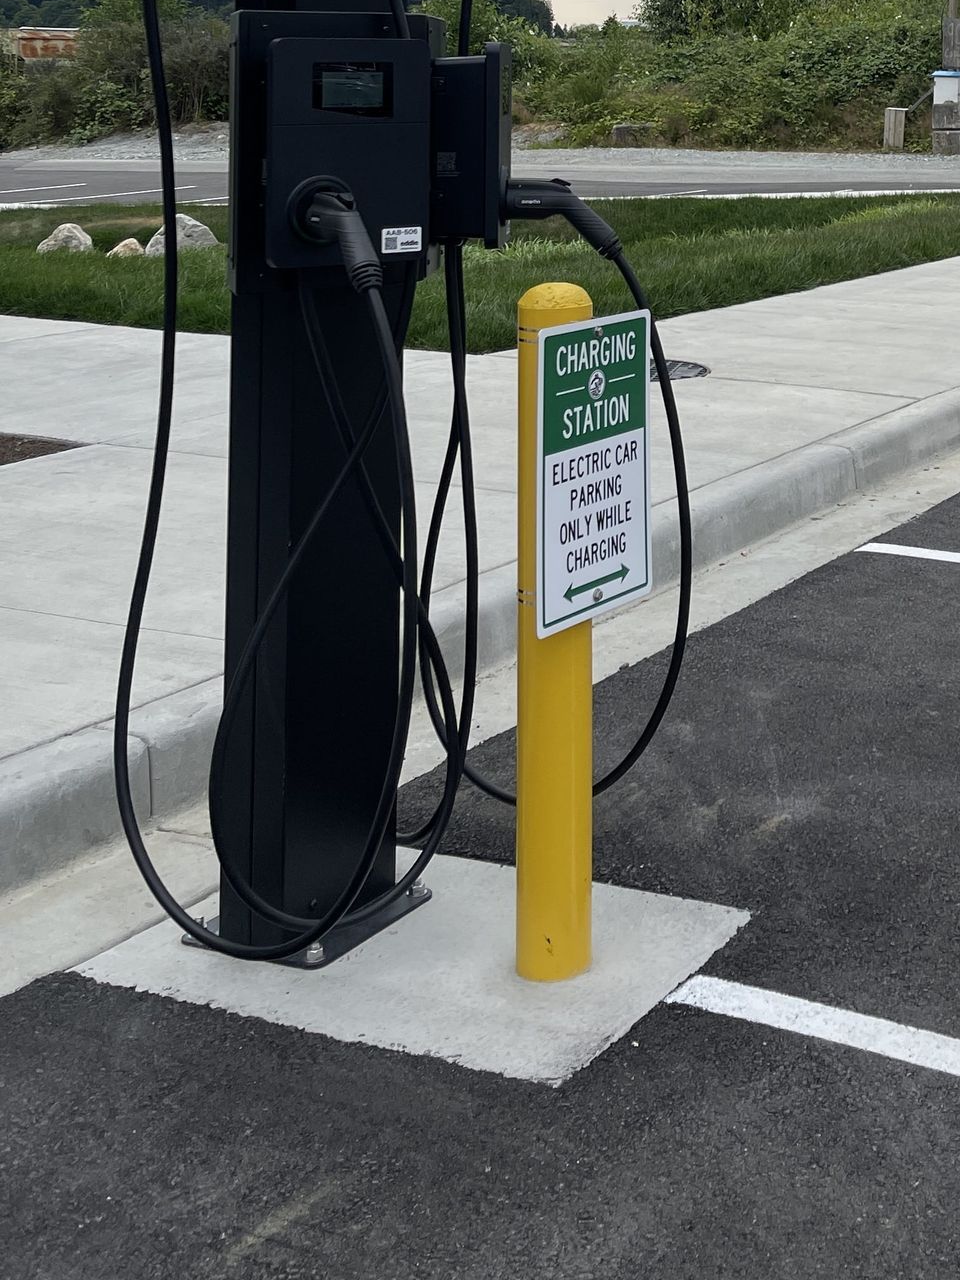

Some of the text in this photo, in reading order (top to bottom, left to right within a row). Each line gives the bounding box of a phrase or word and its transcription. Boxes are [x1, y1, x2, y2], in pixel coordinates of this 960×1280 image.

[555, 331, 637, 377] CHARGING
[562, 393, 630, 440] STATION
[552, 440, 638, 487] ELECTRIC CAR
[570, 474, 622, 511] PARKING
[559, 499, 632, 546] ONLY WHILE
[566, 532, 626, 574] CHARGING
